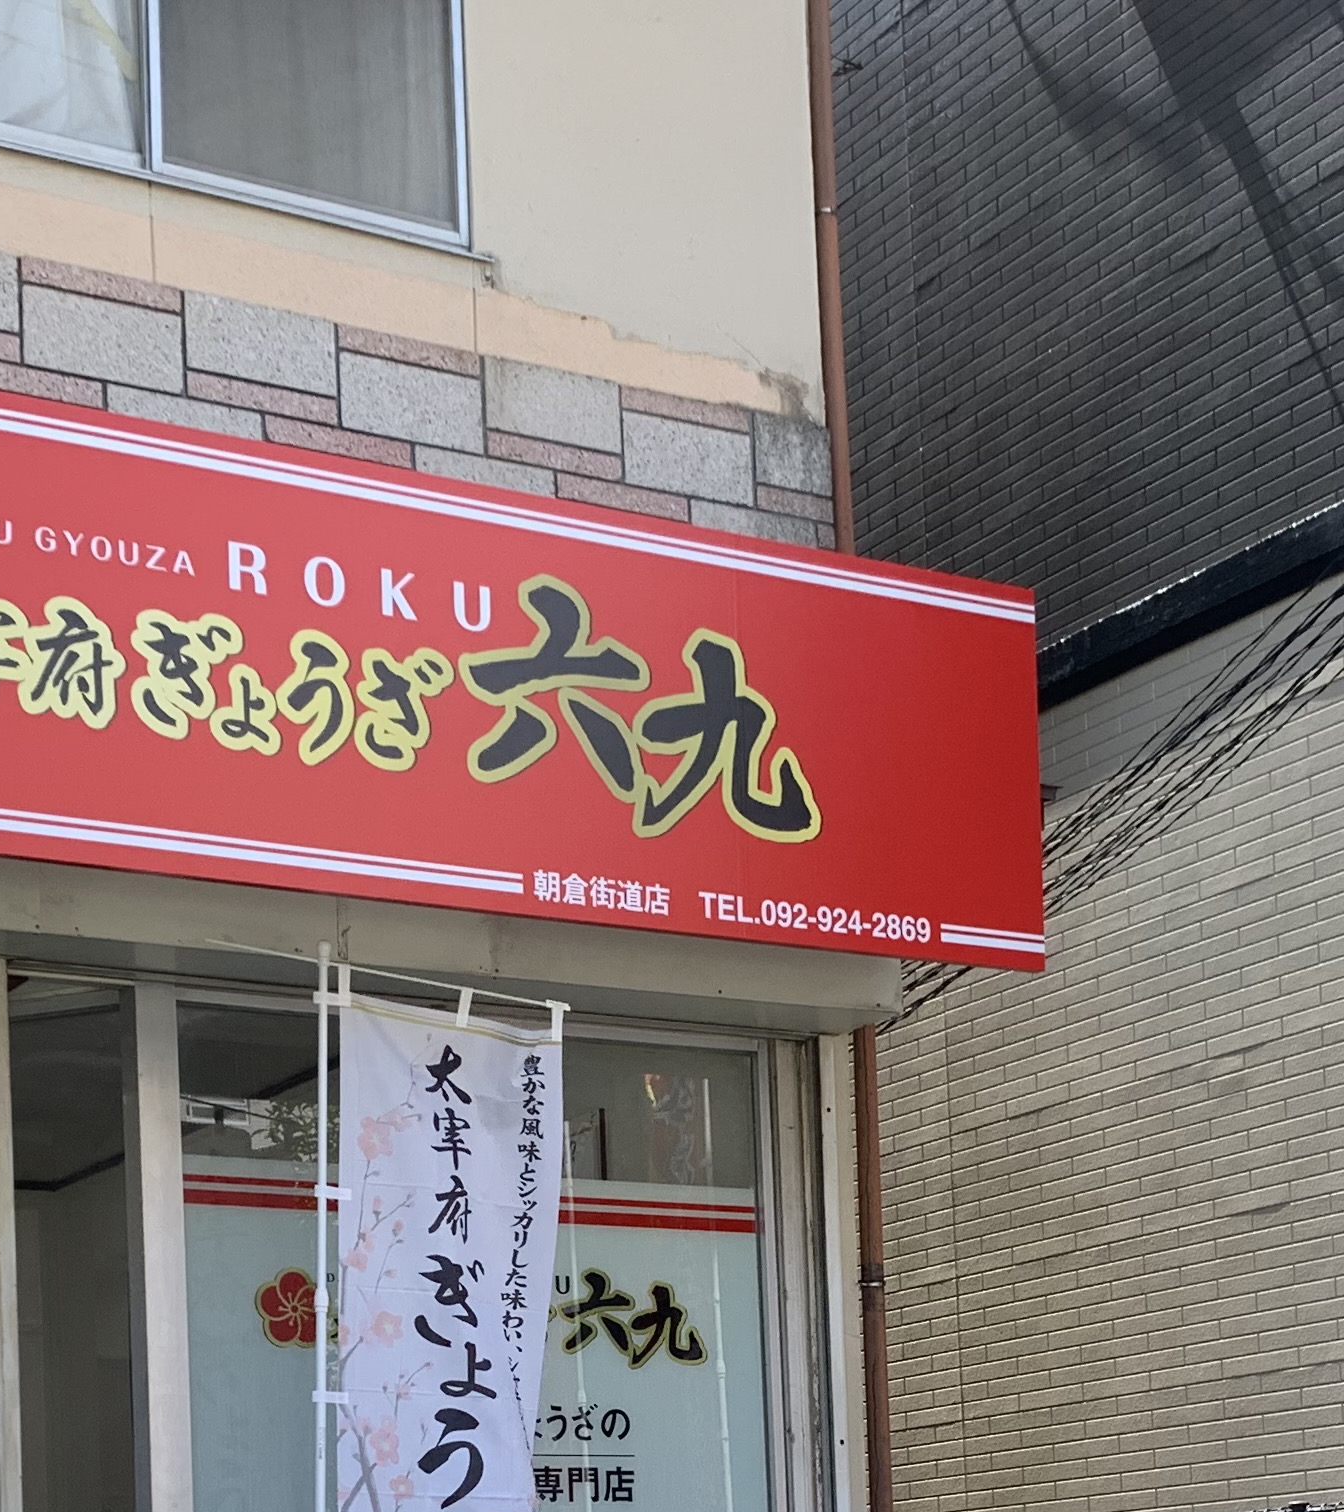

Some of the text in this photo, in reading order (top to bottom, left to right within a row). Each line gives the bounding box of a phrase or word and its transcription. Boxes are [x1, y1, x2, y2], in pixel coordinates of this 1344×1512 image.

[34, 525, 196, 577] GYOUZA
[227, 540, 492, 632] ROKU
[532, 870, 931, 943] 朝倉街道店 TEL.092-924-2869
[561, 1271, 704, 1365] 六九
[534, 1465, 635, 1503] 専門店
